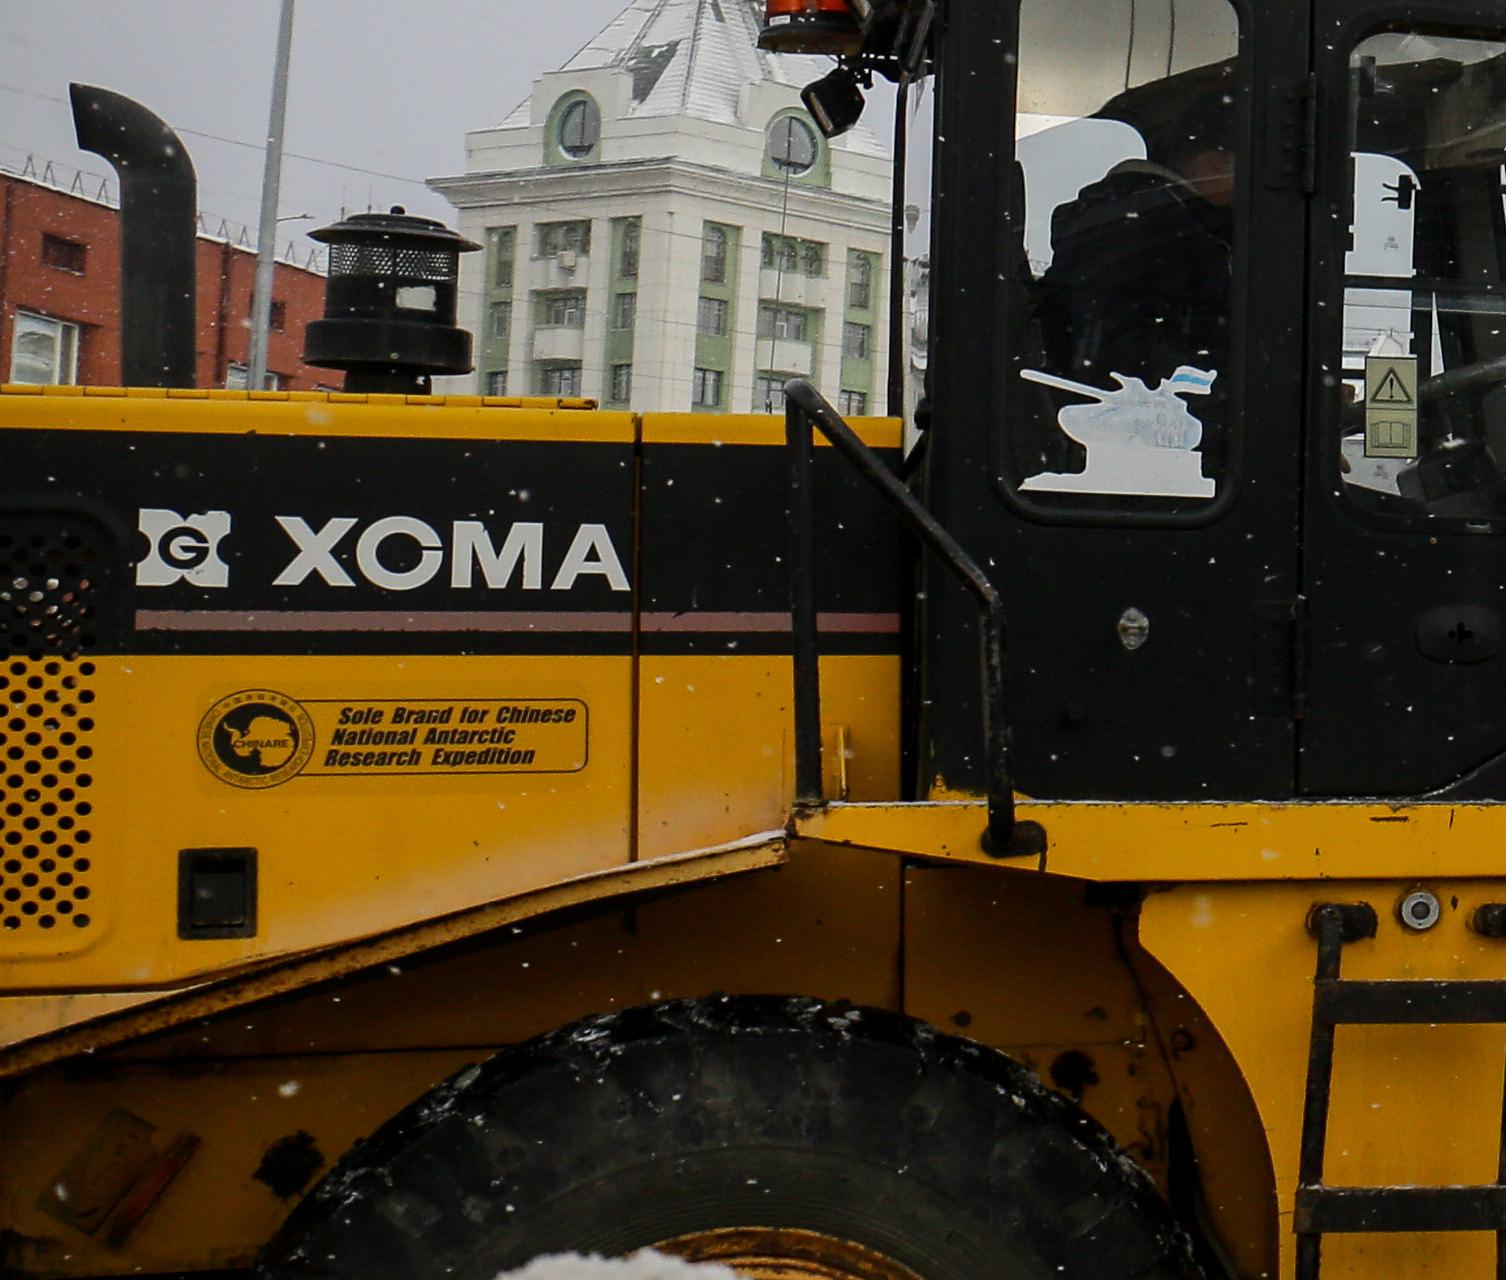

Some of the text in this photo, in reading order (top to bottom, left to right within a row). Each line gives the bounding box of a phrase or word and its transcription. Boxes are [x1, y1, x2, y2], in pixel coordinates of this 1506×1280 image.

[338, 706, 576, 725] Sole Brand for Chinese
[330, 727, 516, 746] National Antarctic
[323, 747, 536, 767] Research Expedition
